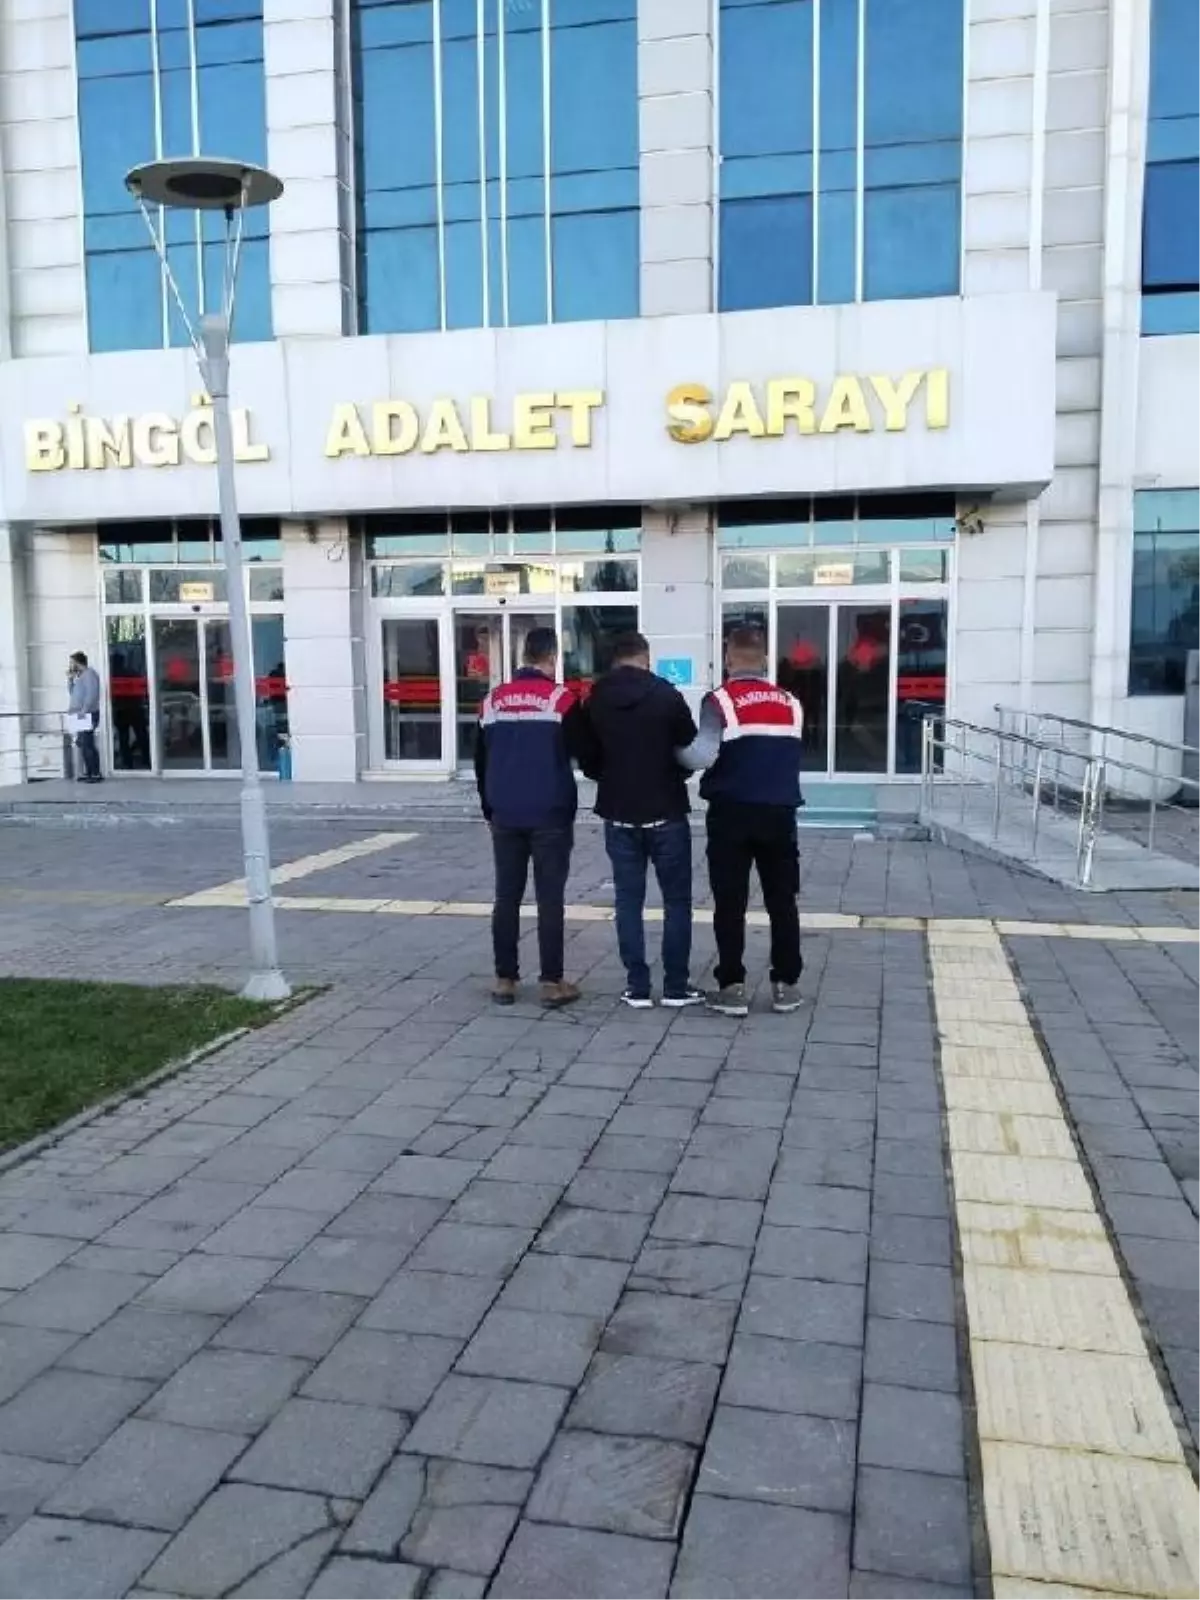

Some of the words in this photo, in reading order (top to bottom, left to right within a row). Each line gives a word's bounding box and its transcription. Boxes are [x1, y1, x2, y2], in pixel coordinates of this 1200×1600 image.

[24, 391, 270, 471] BİNGÖL
[325, 390, 605, 457] ADALET
[666, 368, 950, 444] SARAYI
